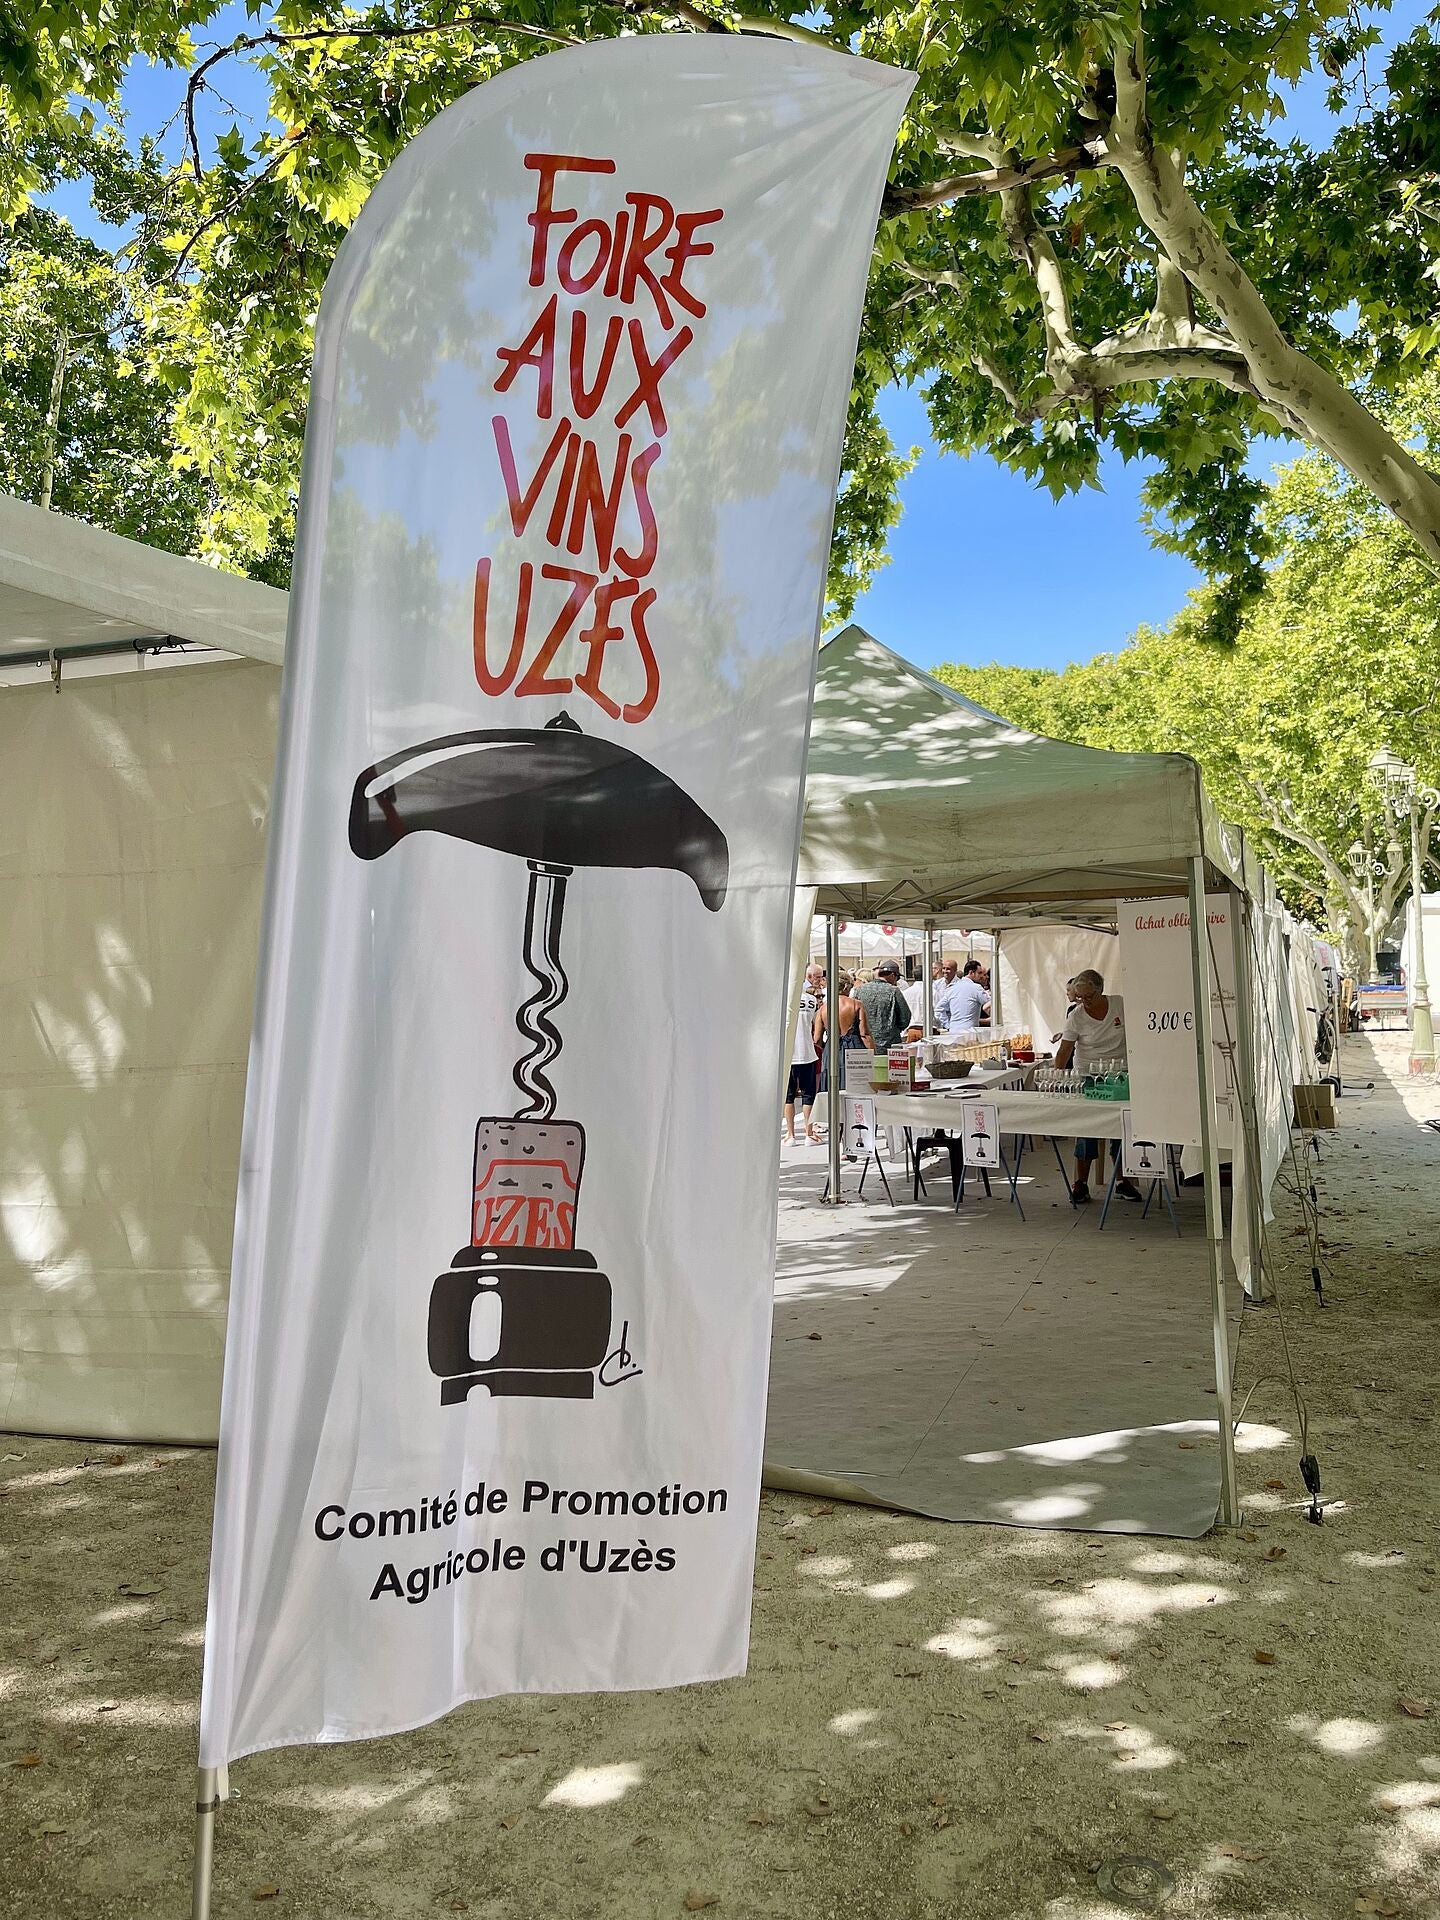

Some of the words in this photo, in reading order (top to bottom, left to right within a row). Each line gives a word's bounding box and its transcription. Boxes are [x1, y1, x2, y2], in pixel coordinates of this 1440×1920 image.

[524, 153, 724, 331] FOIRE
[493, 293, 693, 438] AUX
[491, 415, 662, 578] VINS
[1135, 915, 1165, 930] Achat
[1147, 1011, 1179, 1034] 3,00
[1183, 1011, 1193, 1031] €
[314, 1488, 457, 1542] Comité
[464, 1482, 508, 1516] de
[522, 1480, 728, 1515] Promotion
[369, 1538, 526, 1604] Agricole
[540, 1539, 677, 1573] d'Uzès
